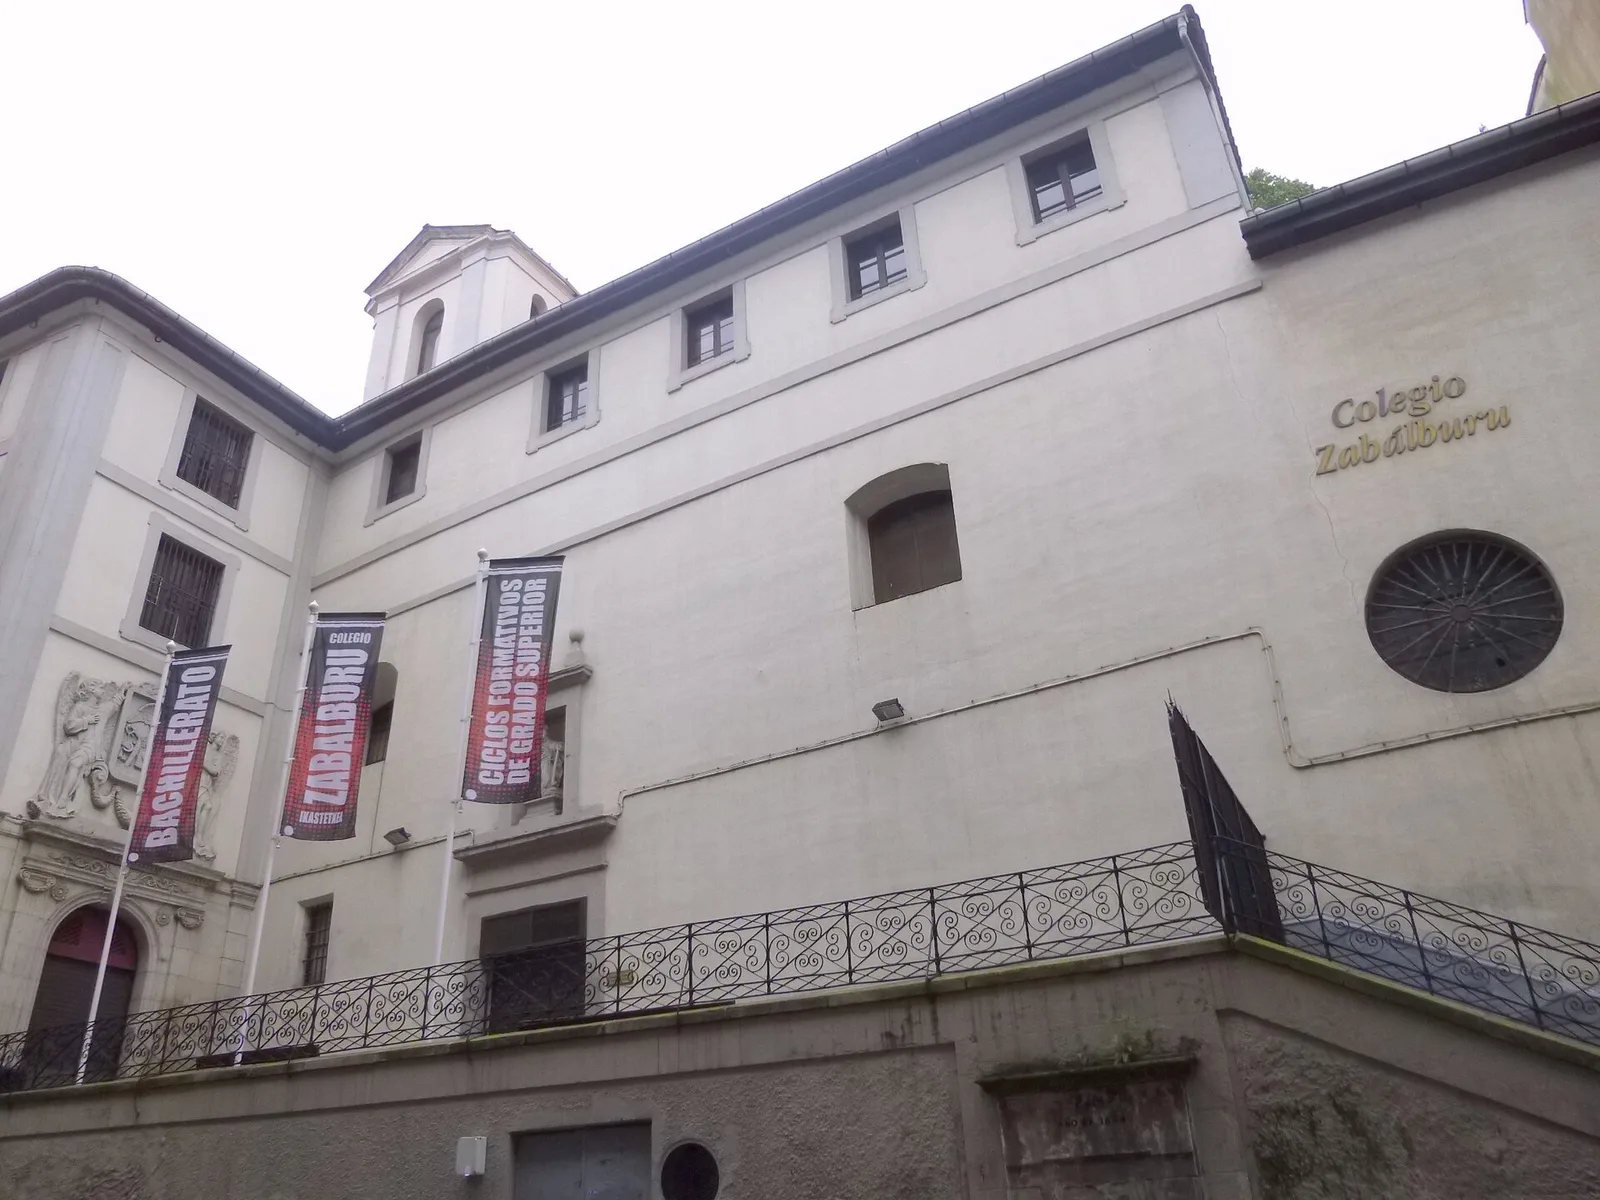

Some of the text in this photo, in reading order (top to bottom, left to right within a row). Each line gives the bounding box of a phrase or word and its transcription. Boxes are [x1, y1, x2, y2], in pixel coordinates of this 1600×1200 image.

[1316, 405, 1511, 475] Zabálburu
[1331, 374, 1466, 429] Colegio
[329, 632, 371, 644] COLEGIO
[478, 578, 523, 786] CICLOS FORMATIVOS
[507, 578, 548, 785] DE GRADO SUPERIOR
[145, 665, 216, 848] BACHILLERATO
[303, 649, 369, 806] ZABALBURU
